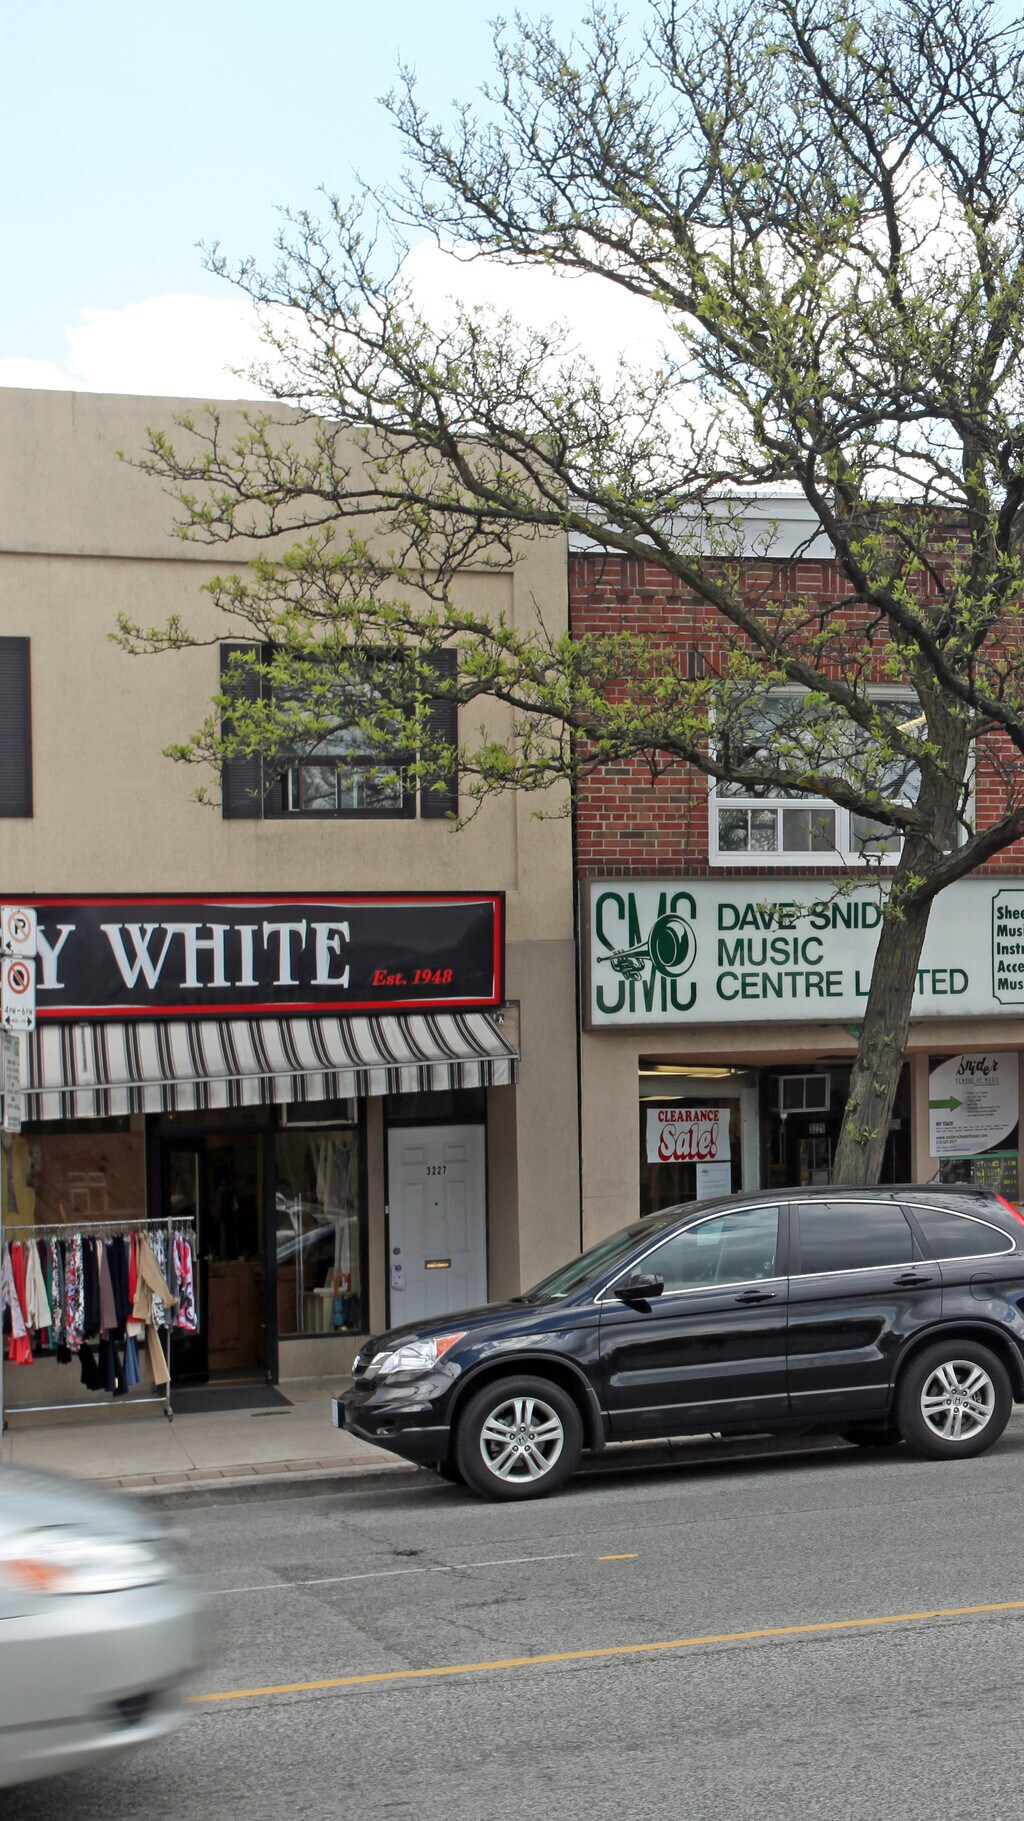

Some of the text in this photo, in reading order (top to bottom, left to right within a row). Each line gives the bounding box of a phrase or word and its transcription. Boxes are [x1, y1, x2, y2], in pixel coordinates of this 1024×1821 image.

[717, 902, 886, 931] DAVE SNID
[101, 918, 351, 990] WHITE
[717, 936, 824, 967] MUSIC
[372, 968, 454, 986] Est. 1948
[716, 968, 969, 1001] CENTRE LTED
[658, 1109, 720, 1123] CLEARANCE
[657, 1122, 720, 1162] Sale!
[426, 1166, 448, 1176] 3227
